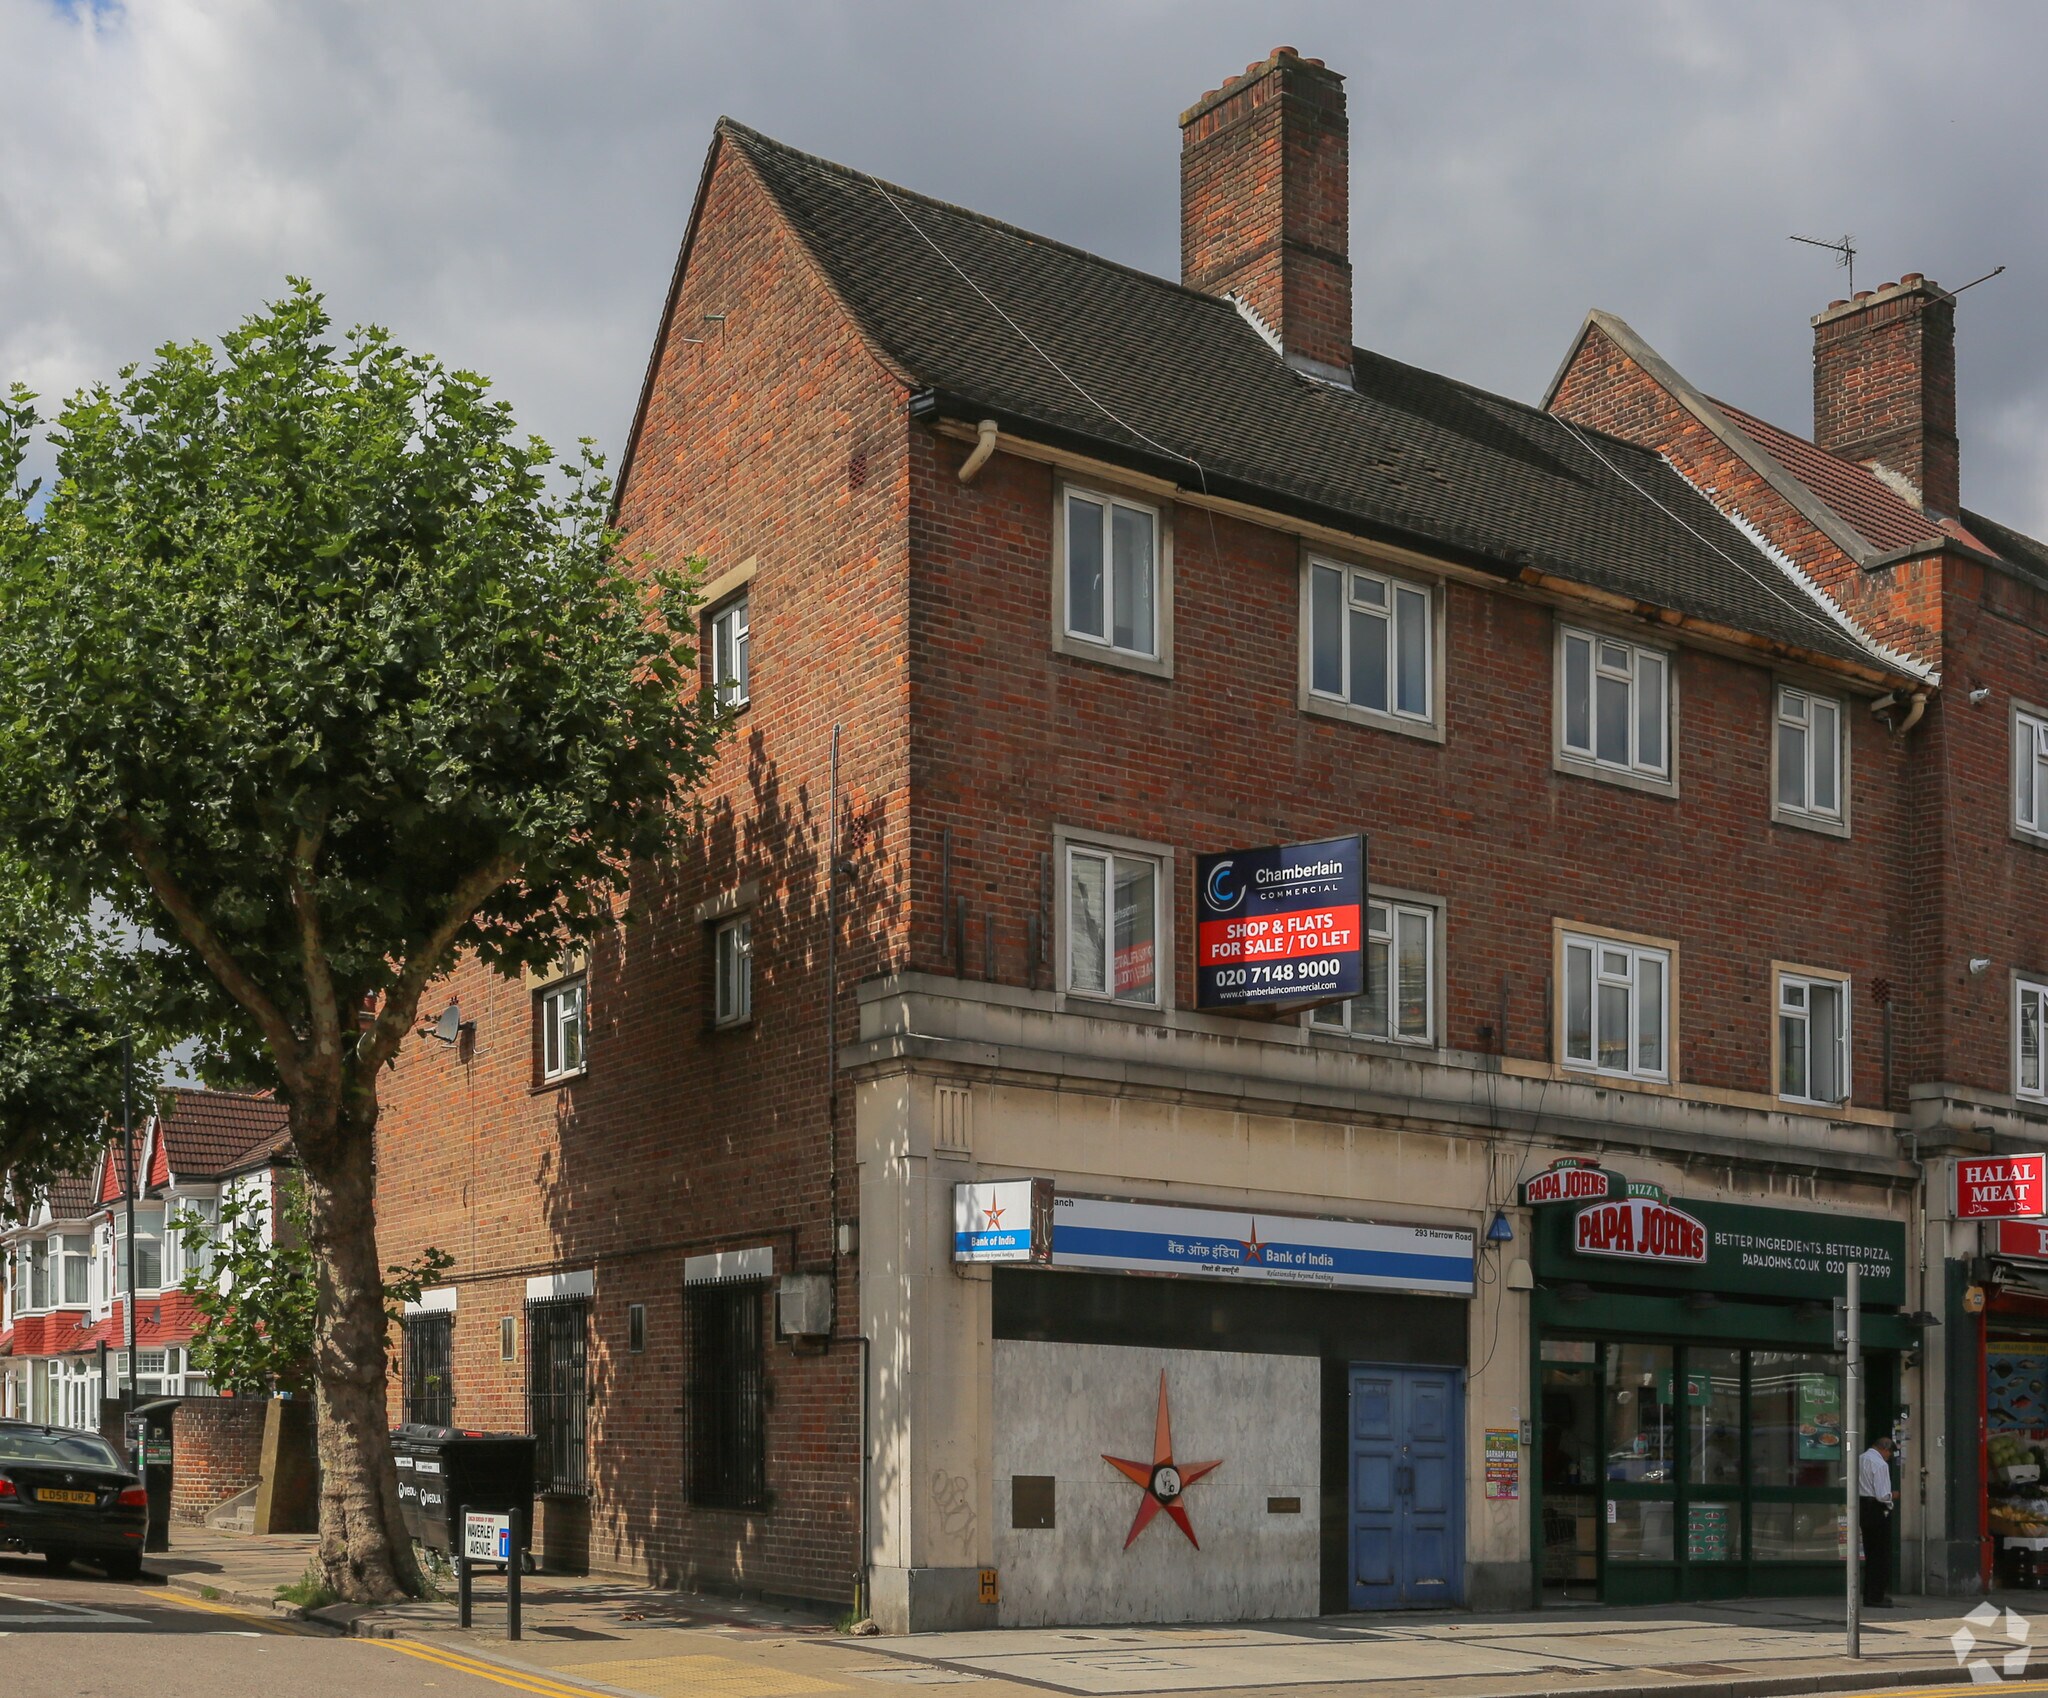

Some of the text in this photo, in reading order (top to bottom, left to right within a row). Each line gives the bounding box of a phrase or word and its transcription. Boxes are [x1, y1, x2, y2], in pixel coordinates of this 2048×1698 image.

[1255, 860, 1343, 883] Chamberlain
[1260, 884, 1338, 900] COMMERCIAL
[1227, 913, 1333, 939] SHOP & FLATS
[1211, 943, 1241, 958] FOR
[1244, 937, 1284, 955] SALE
[1298, 934, 1319, 949] TO
[1322, 930, 1350, 947] LET
[1216, 959, 1340, 987] 020 7148 9000
[1219, 981, 1337, 999] www.chamberlaincommercial.com
[1556, 1159, 1577, 1168] PIZZA
[1965, 1164, 2036, 1184] HALAL
[1528, 1174, 1561, 1201] PAPA
[1627, 1183, 1659, 1198] PIZZA
[1971, 1184, 2030, 1203] MEAT
[1054, 1199, 1074, 1208] anch
[1968, 1204, 1989, 1215] حلال
[2009, 1202, 2031, 1213] حلال
[1415, 1228, 1472, 1241] 293 Harrow Road
[1578, 1205, 1634, 1251] PAPA
[971, 1235, 1015, 1247] Bank of India
[1714, 1232, 1893, 1261] BETTER INGREDIENTS. BETTER PIZZA.
[1212, 1244, 1240, 1260] इंडिया
[1266, 1249, 1334, 1266] Bank of India
[1742, 1253, 1820, 1272] PAPAJOHNS.CO.UK
[1826, 1260, 1845, 1274] 020
[1870, 1265, 1891, 1278] 2999
[1267, 1269, 1334, 1282] Relationship beyond banking
[154, 1428, 162, 1438] P
[1506, 1450, 1518, 1459] PARK
[467, 1523, 495, 1540] WAVERLEY
[469, 1540, 491, 1556] AVENUE
[981, 1573, 996, 1595] H
